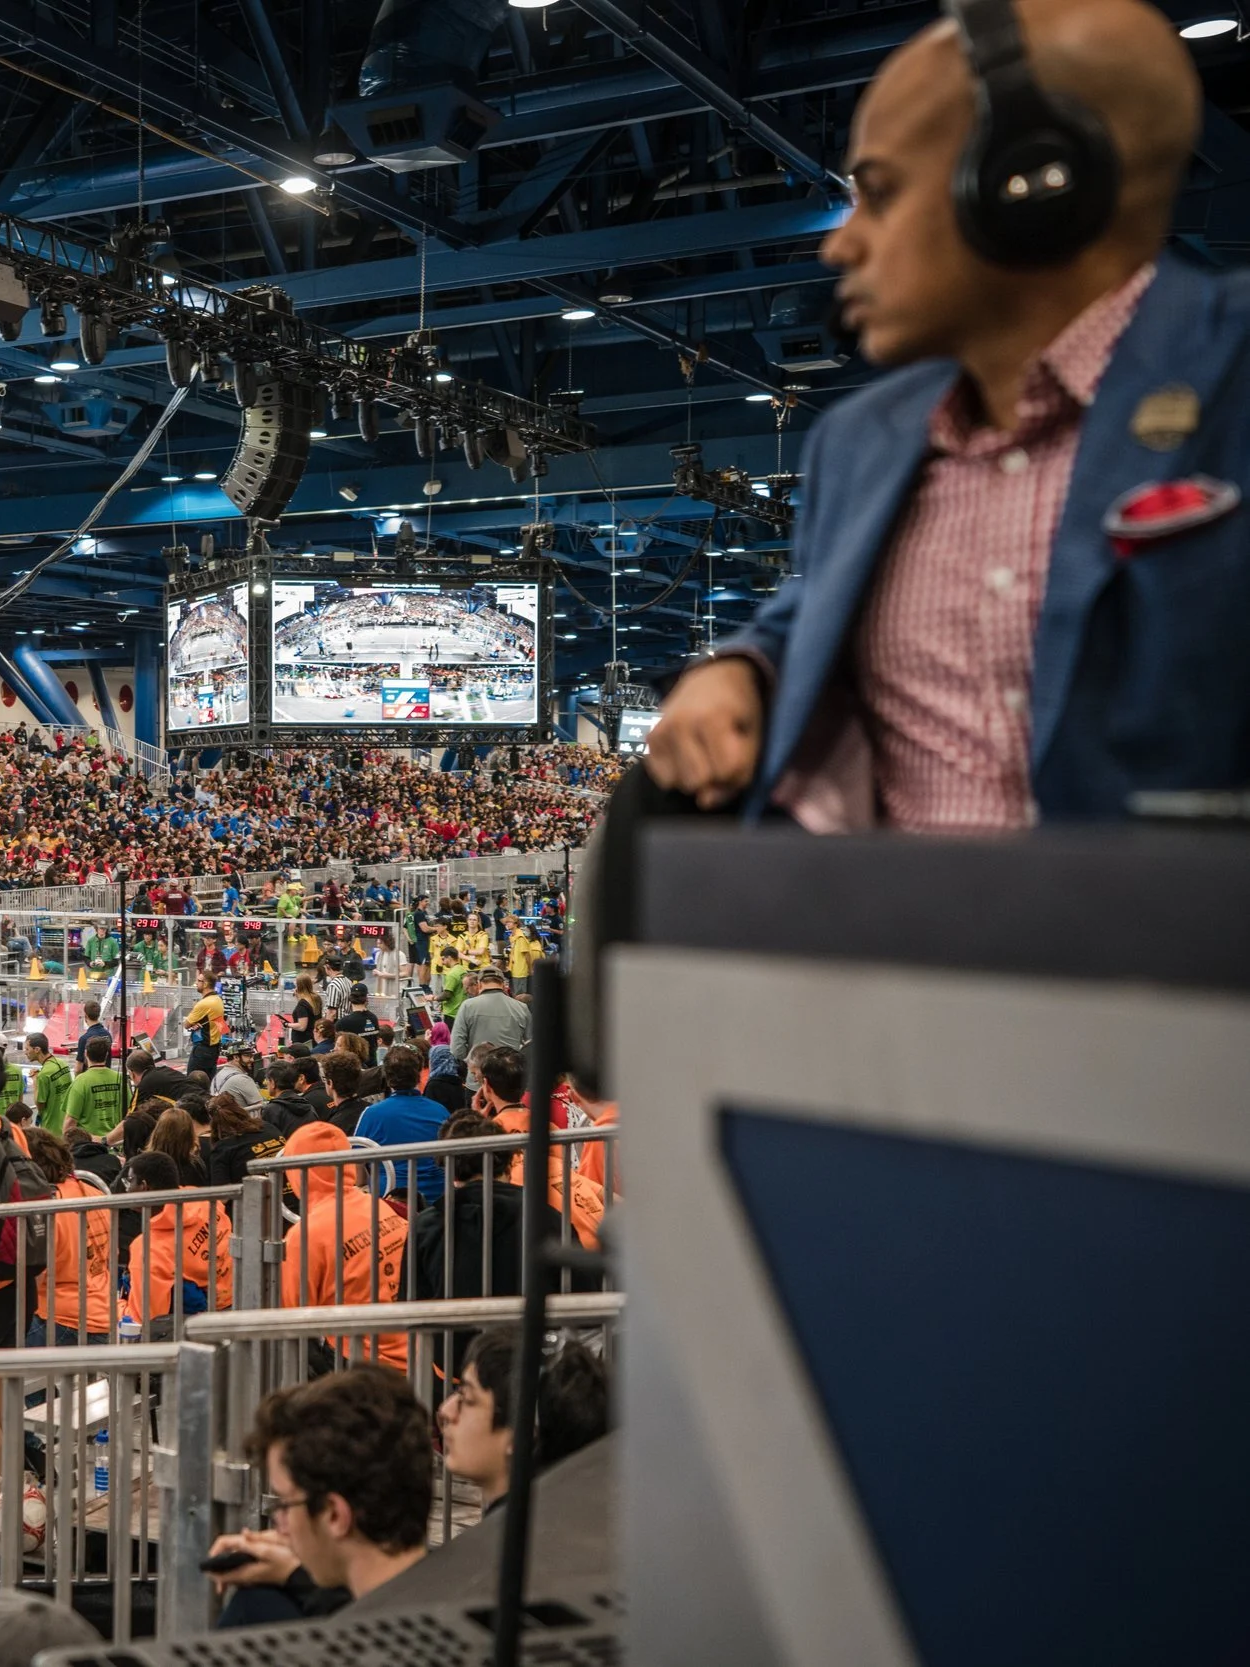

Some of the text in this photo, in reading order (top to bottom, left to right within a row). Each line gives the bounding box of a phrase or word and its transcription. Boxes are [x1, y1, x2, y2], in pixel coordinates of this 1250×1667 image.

[136, 919, 159, 928] 2910
[198, 920, 214, 929] 120
[244, 920, 261, 930] 948
[361, 925, 385, 935] 7461
